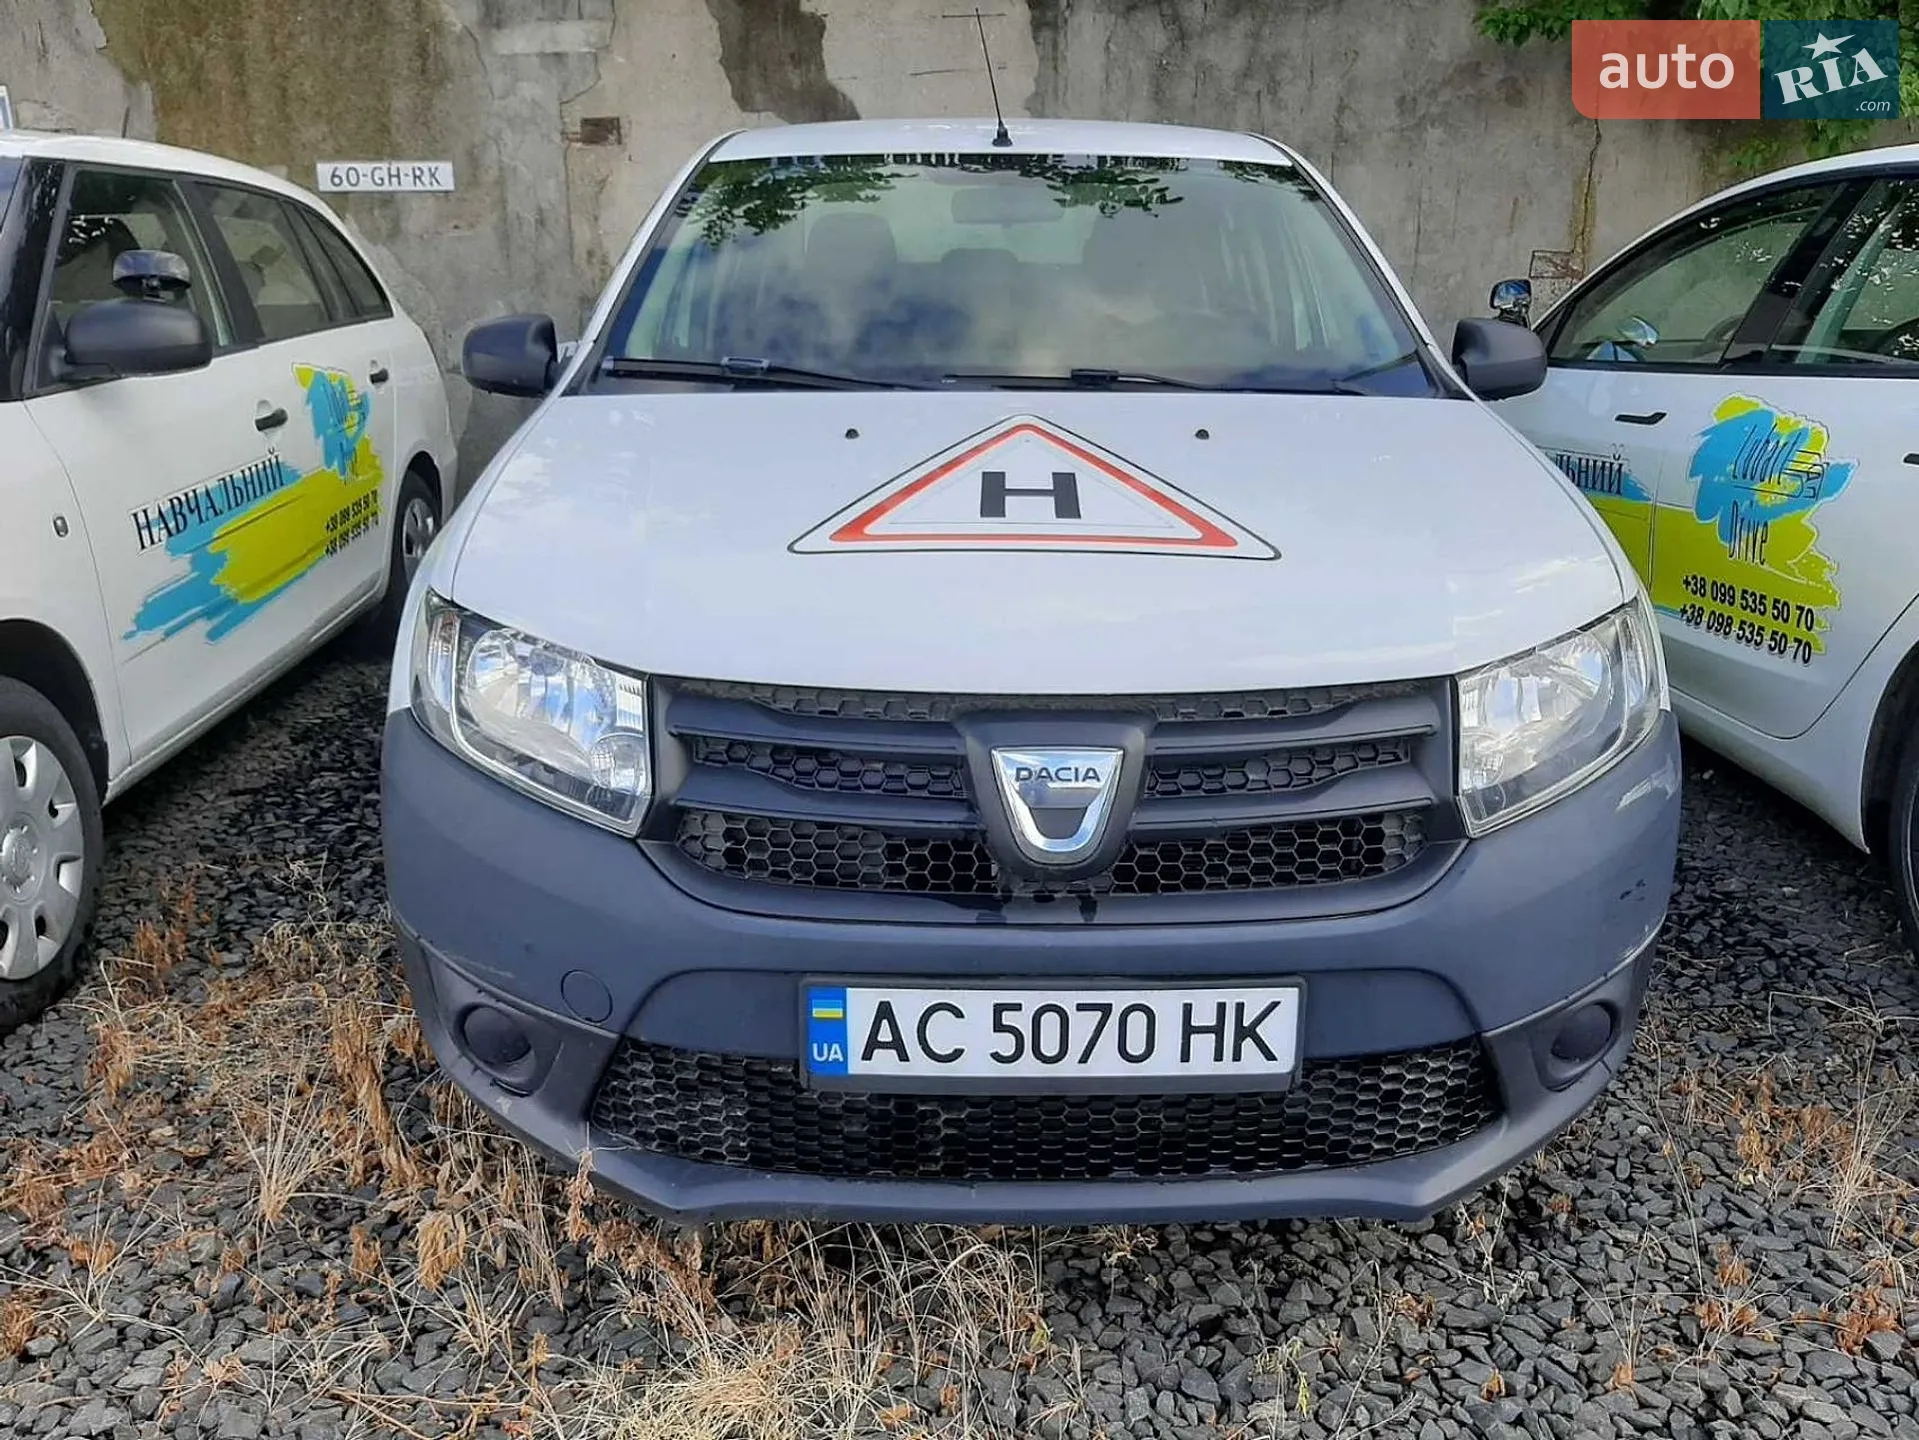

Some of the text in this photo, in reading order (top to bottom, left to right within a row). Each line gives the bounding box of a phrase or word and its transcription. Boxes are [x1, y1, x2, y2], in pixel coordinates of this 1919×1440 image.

[330, 165, 442, 188] 60-GH-RK
[132, 447, 285, 551] НАВЧАЛЬНИЙ
[1683, 574, 1815, 632] +38 099 535 50 70
[1680, 603, 1812, 664] +38 098 535 50 70
[1015, 766, 1101, 783] DACIA
[812, 1042, 844, 1063] UA
[860, 1000, 1283, 1065] AC 5070 HK
